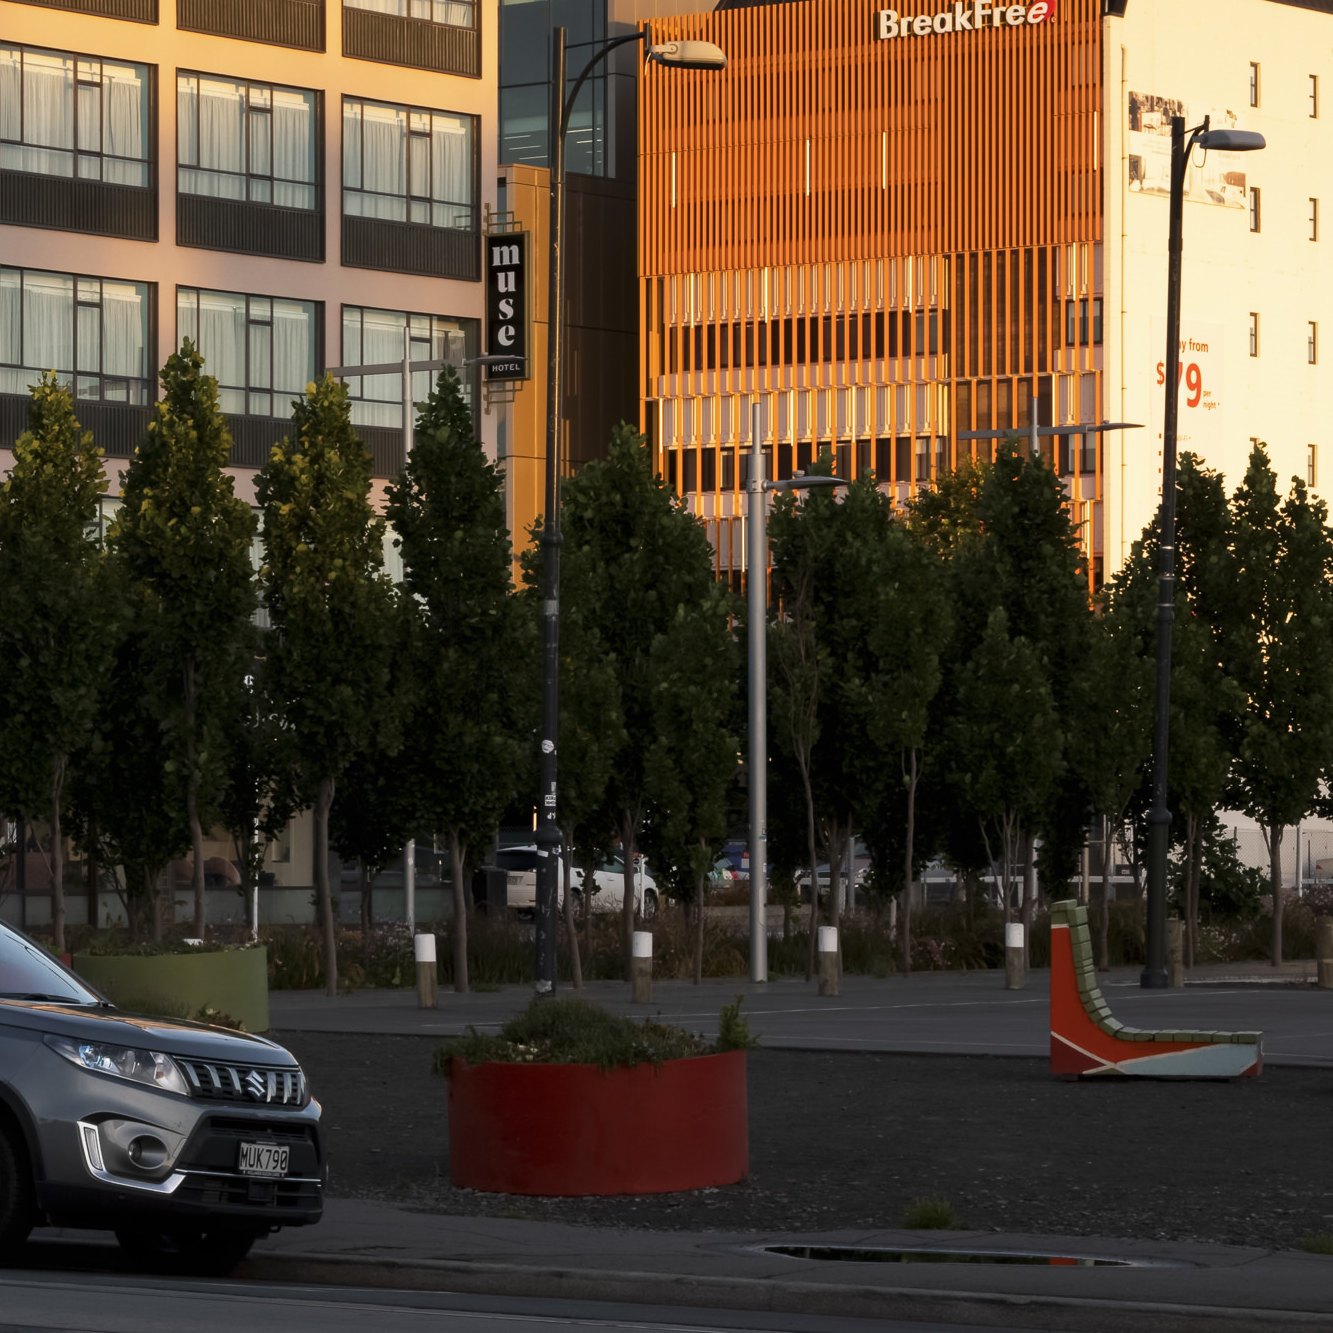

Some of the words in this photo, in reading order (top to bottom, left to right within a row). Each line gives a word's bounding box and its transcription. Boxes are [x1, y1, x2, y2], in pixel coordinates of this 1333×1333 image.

[491, 244, 521, 347] muse
[1189, 337, 1209, 353] from
[491, 363, 521, 372] HOTEL
[239, 1146, 288, 1171] MUK790
